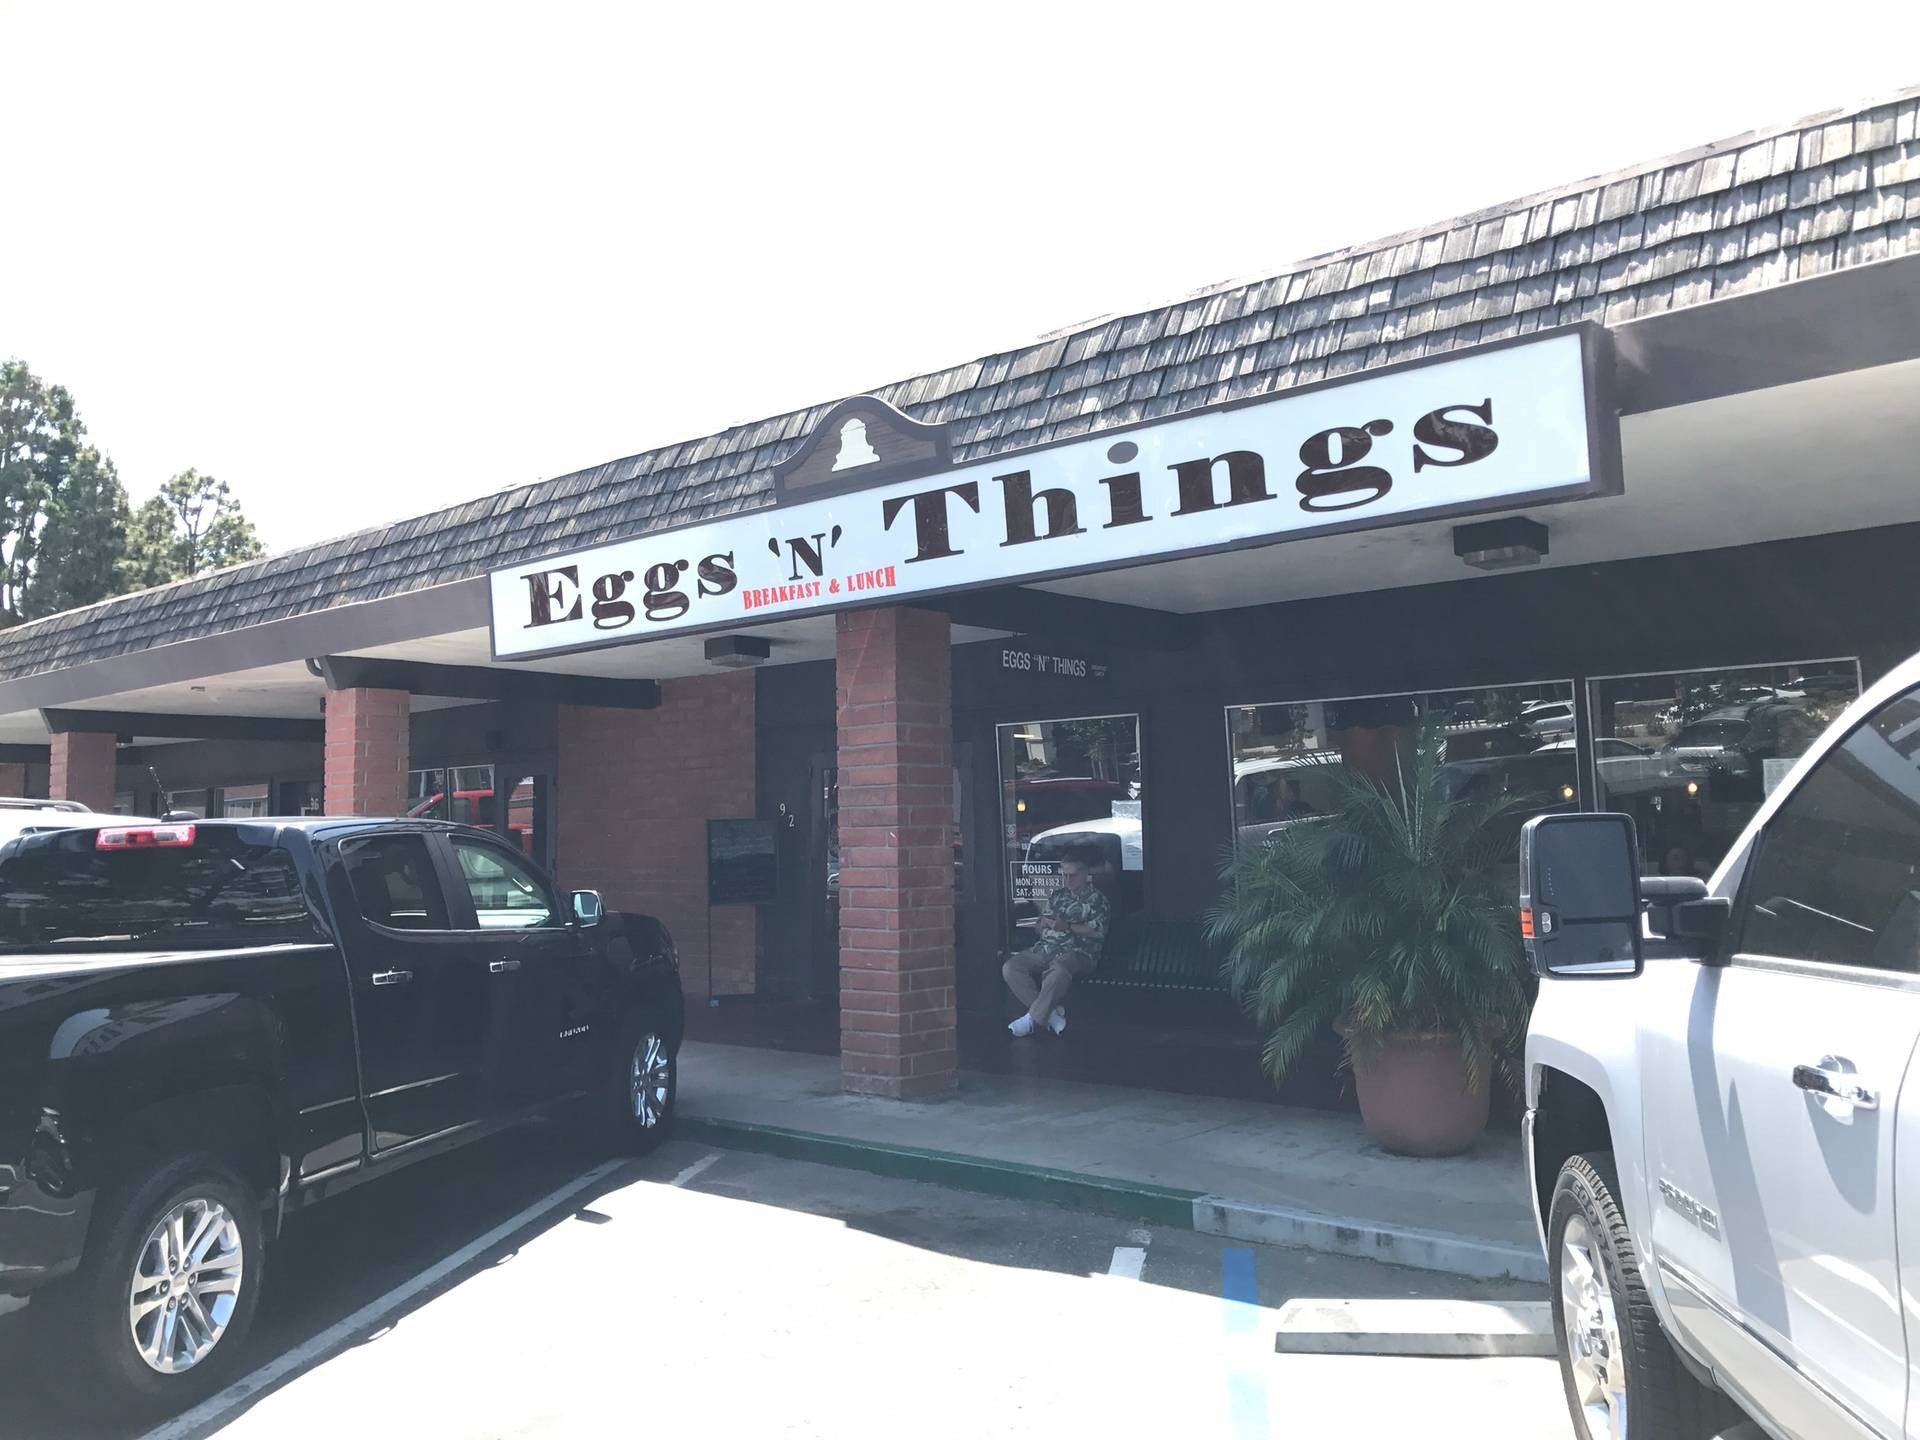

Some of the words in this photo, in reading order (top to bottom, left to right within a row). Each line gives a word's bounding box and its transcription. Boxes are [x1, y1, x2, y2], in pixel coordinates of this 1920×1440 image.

[520, 551, 738, 630] Eggs
[882, 398, 1499, 564] Things
[742, 581, 821, 610] BREAKFAST
[829, 578, 840, 594] &
[847, 566, 897, 592] LUNCH
[1002, 650, 1031, 670] EGGS
[1052, 657, 1086, 677] THINGS
[1022, 864, 1052, 874] HOURS
